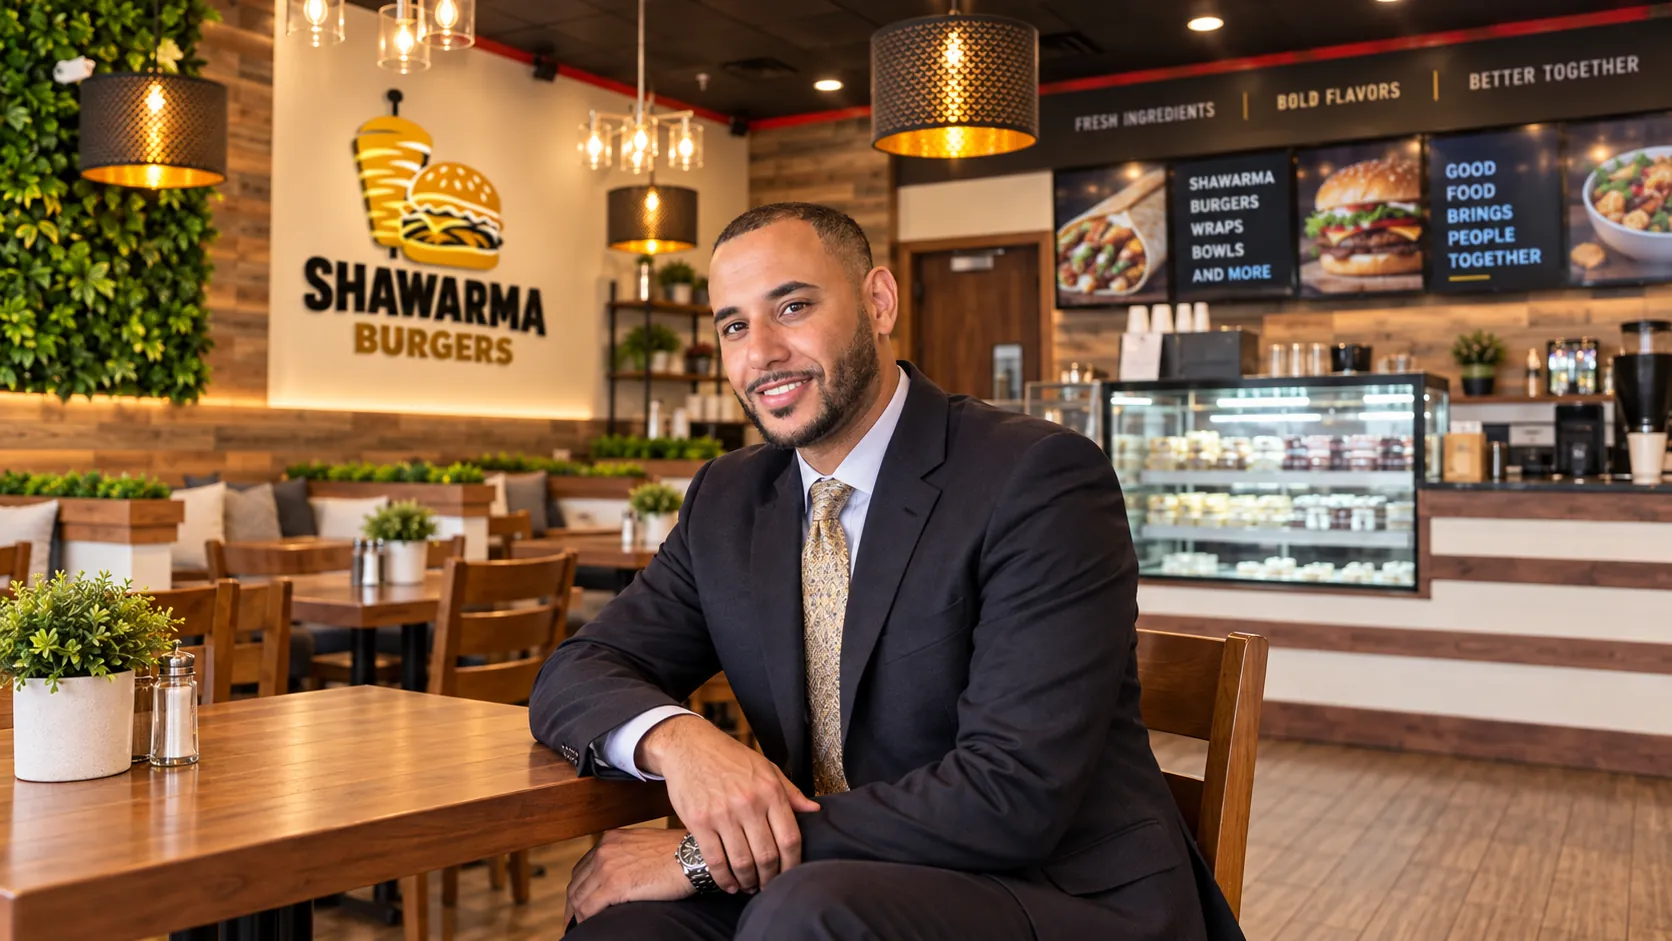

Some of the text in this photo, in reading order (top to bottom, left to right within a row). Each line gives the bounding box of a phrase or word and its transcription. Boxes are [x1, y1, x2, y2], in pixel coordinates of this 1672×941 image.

[1469, 55, 1639, 90] BETTER TOGETHER
[1277, 81, 1400, 111] BOLD FLAVORS
[1075, 101, 1215, 132] FRESH INGREDIENTS
[1445, 160, 1496, 179] GOOD
[1189, 170, 1275, 191] SHAWARMA
[1446, 182, 1496, 202] FOOD
[1190, 194, 1259, 214] BURGERS
[1447, 203, 1513, 224] BRINGS
[1190, 219, 1244, 236] WRAPS
[1448, 226, 1516, 246] PEOPLE
[1192, 242, 1244, 260] BOWLS
[1448, 247, 1542, 269] TOGETHER
[1192, 264, 1271, 283] AND MORE
[304, 256, 546, 337] SHAWARMA
[354, 322, 514, 366] BURGERS
